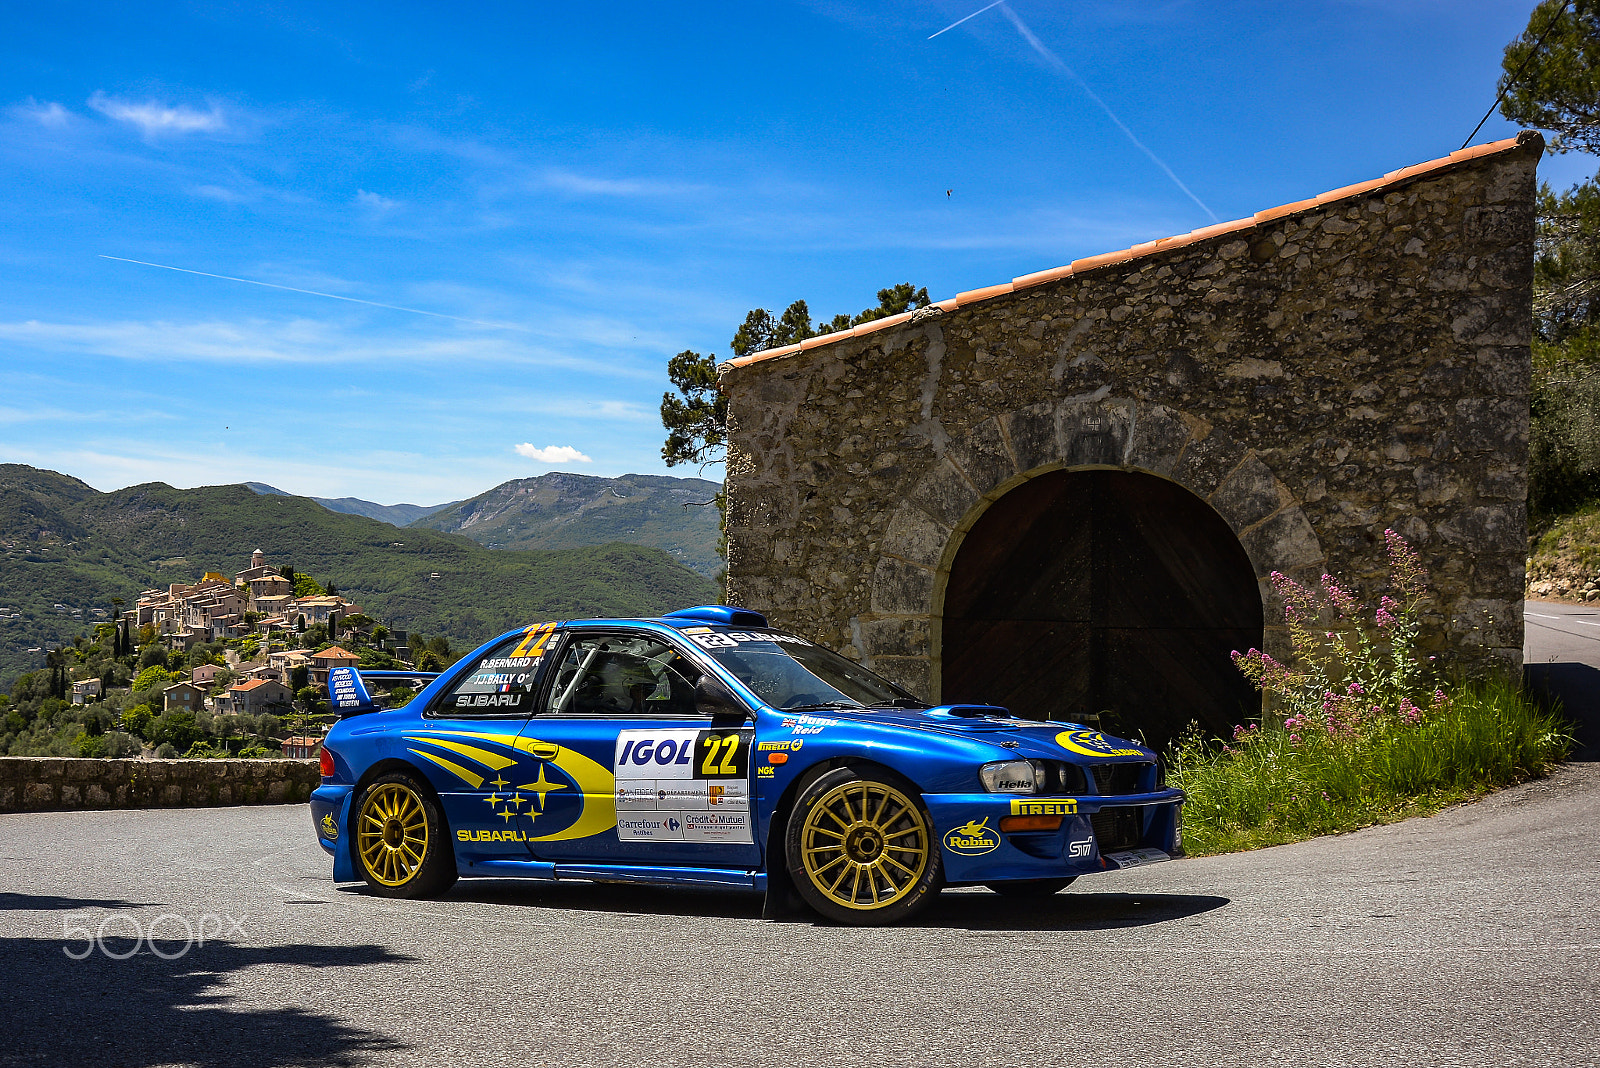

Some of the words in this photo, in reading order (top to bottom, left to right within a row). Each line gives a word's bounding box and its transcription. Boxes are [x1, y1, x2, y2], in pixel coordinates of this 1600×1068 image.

[509, 622, 558, 658] 22
[480, 657, 531, 669] R.BERNARD
[456, 694, 522, 707] SUBARU
[797, 714, 839, 726] Burns
[791, 725, 825, 735] Reid
[757, 741, 792, 751] PIRELLI
[618, 739, 692, 766] IGOL
[701, 734, 740, 775] 22
[757, 766, 775, 775] NGK
[998, 779, 1032, 789] Hella
[1010, 799, 1078, 816] PIRELLI
[619, 819, 661, 829] Carrefour
[686, 815, 709, 824] Crédit
[719, 815, 745, 824] Mutuel
[457, 830, 527, 842] SUBARU
[950, 836, 994, 848] Robin
